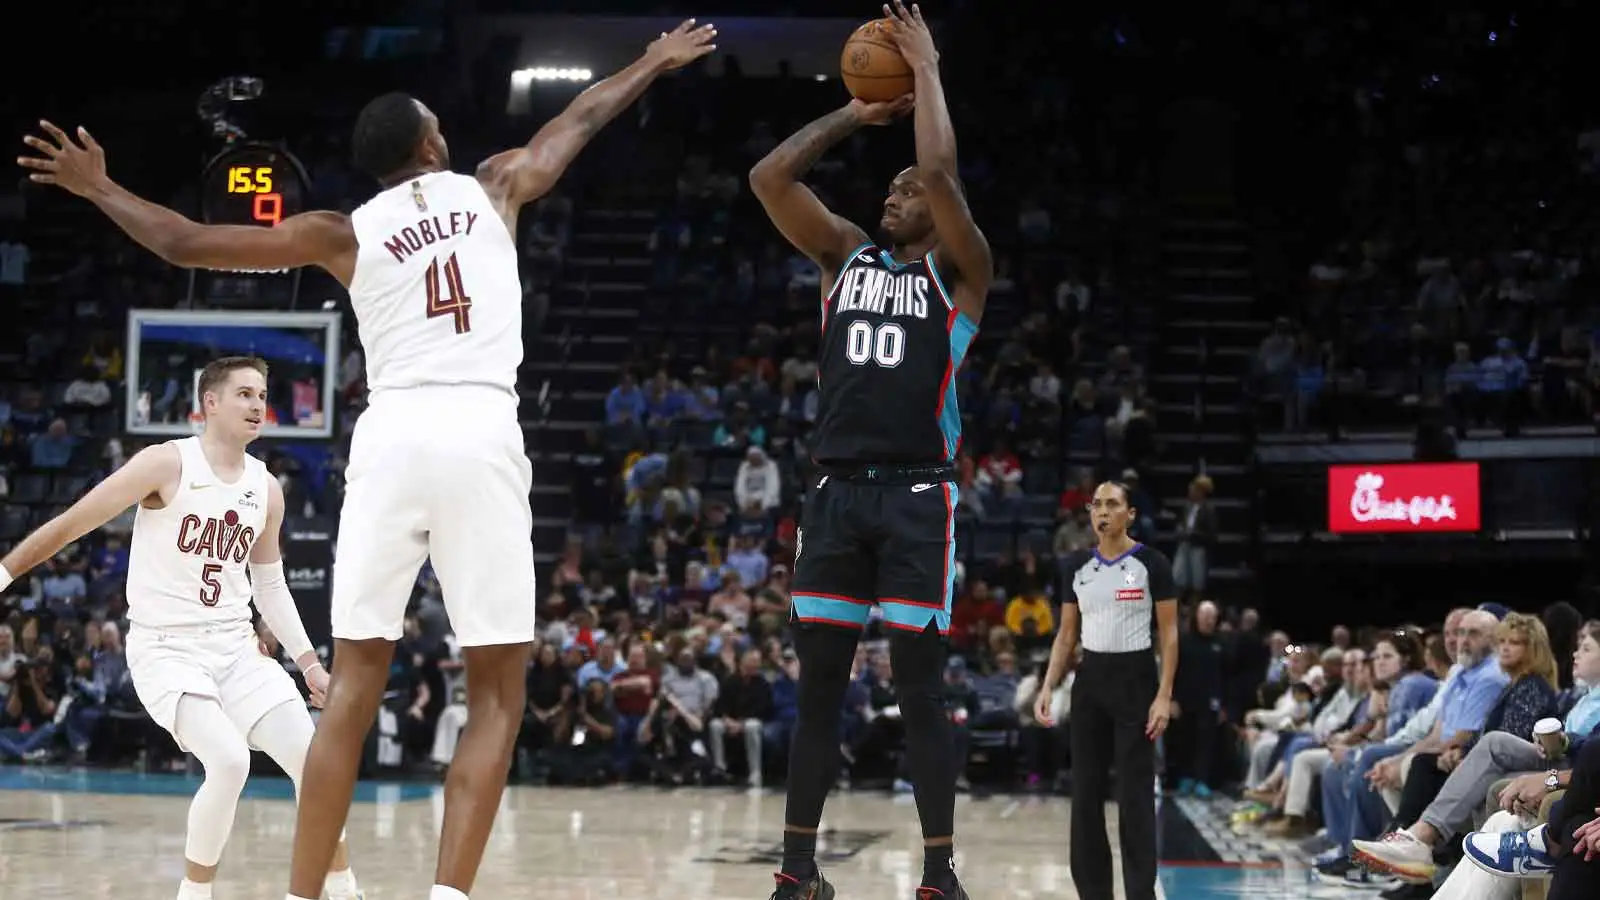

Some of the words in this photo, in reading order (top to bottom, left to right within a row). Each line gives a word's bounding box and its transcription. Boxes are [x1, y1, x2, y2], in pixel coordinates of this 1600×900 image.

[228, 166, 273, 193] 15.5
[253, 192, 283, 226] 9
[383, 210, 478, 264] MOBLEY
[425, 251, 472, 334] 4
[836, 267, 929, 320] MEMPHIS
[846, 320, 906, 369] 00
[177, 511, 255, 564] CAVS
[199, 563, 223, 607] 5
